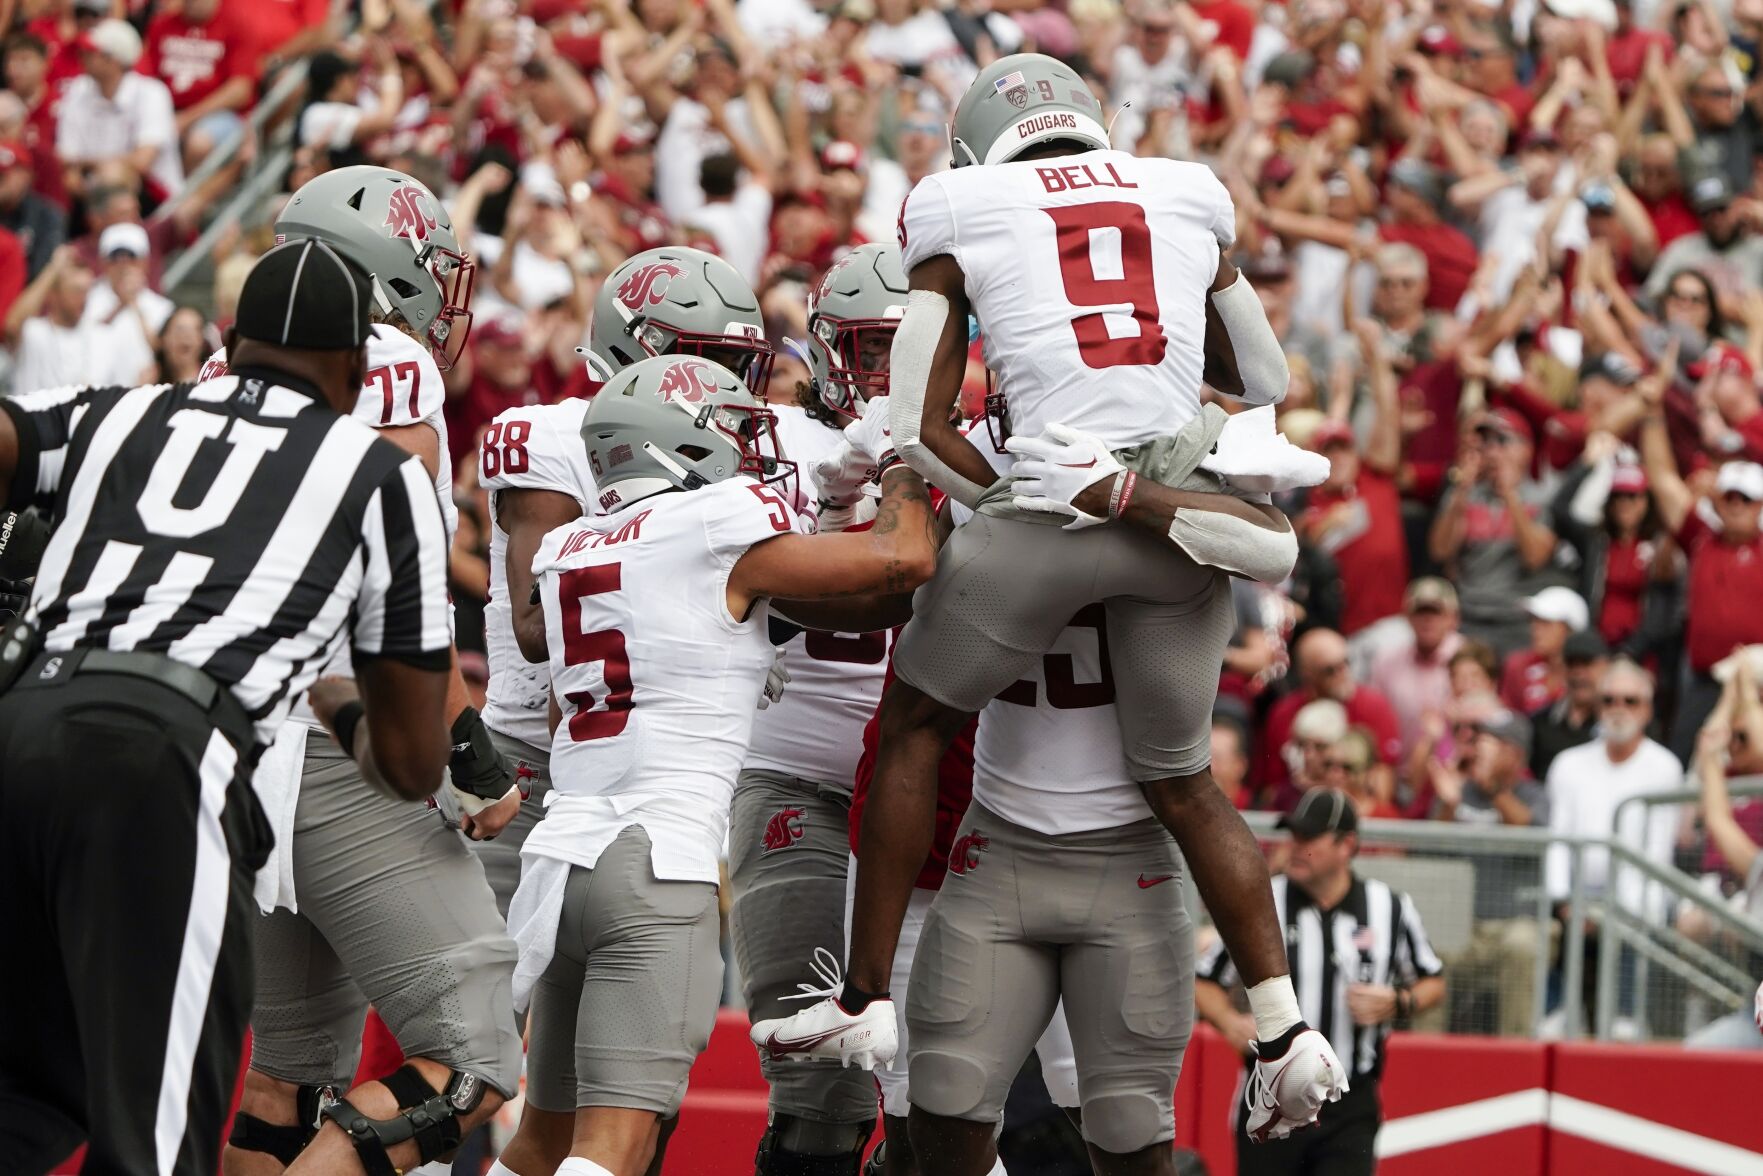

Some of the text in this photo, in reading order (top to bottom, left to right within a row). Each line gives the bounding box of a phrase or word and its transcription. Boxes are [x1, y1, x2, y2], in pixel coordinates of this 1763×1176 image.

[1036, 79, 1055, 101] 9
[1017, 114, 1077, 139] COUGARS
[1034, 162, 1139, 193] BELL
[1038, 200, 1169, 369] 9
[743, 326, 758, 338] WSU
[364, 361, 421, 424] 77
[136, 408, 289, 538] U
[483, 420, 532, 479] 88
[590, 449, 604, 476] 5
[745, 483, 792, 532] 5
[555, 508, 653, 561] VICTOR
[559, 561, 637, 743] 5
